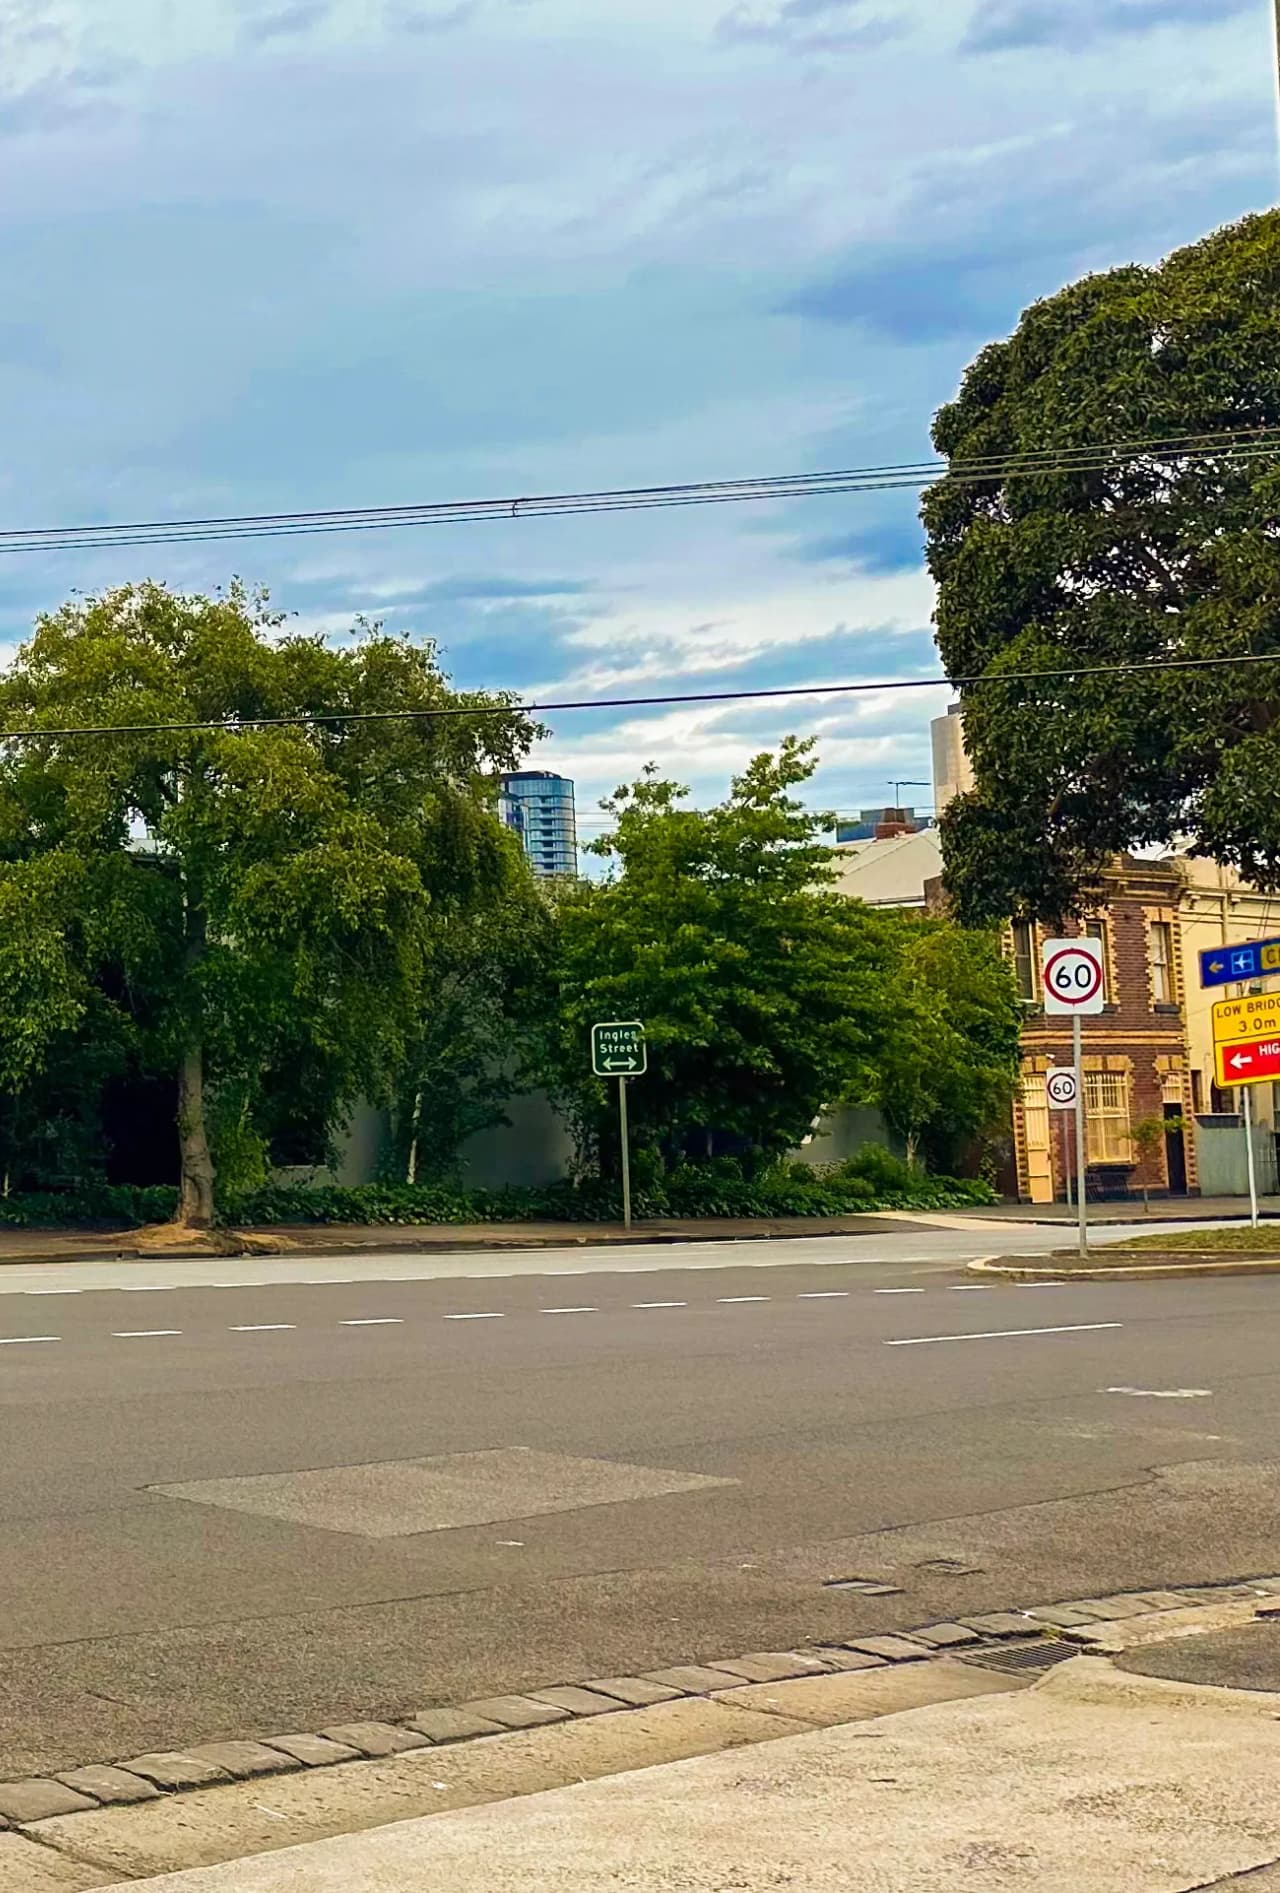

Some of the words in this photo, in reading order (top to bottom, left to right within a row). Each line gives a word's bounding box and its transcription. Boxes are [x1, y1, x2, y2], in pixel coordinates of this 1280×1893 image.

[1056, 963, 1092, 989] 60
[1216, 1004, 1241, 1018] LOW
[600, 1030, 637, 1042] Ingles
[600, 1043, 639, 1053] Street
[1052, 1081, 1073, 1095] 60
